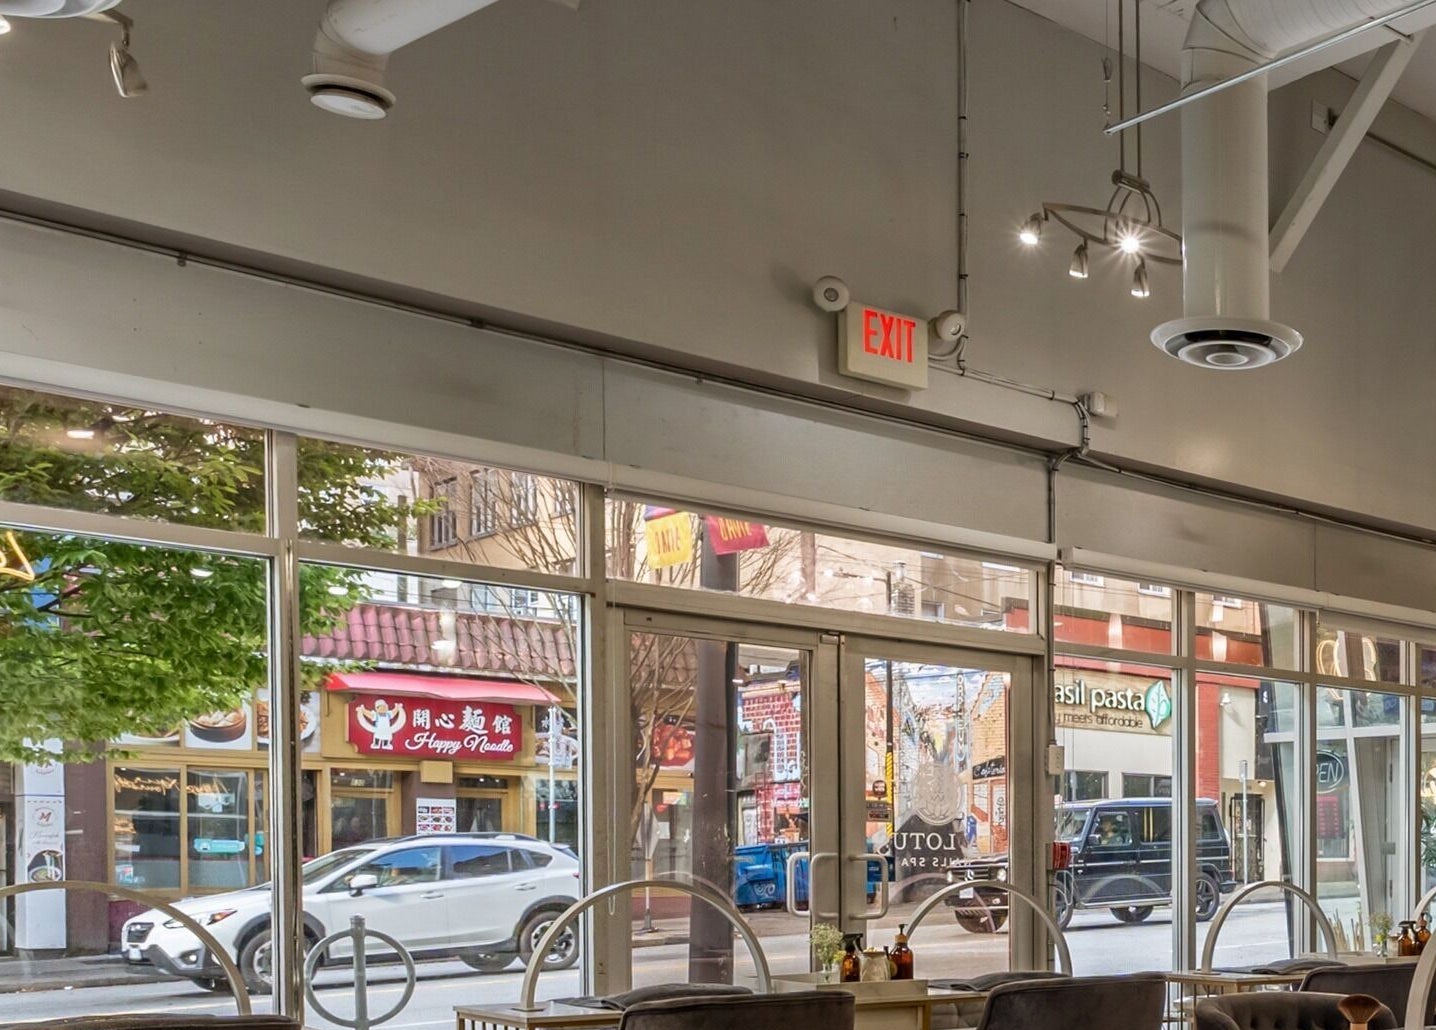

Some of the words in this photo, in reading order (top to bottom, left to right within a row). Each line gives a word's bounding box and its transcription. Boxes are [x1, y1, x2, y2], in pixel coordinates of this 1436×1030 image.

[863, 309, 916, 364] EXIT
[1090, 687, 1146, 713] pasta
[1063, 712, 1093, 724] meets
[1096, 713, 1143, 729] affordable
[405, 731, 463, 755] Happy
[463, 734, 514, 754] Noodle
